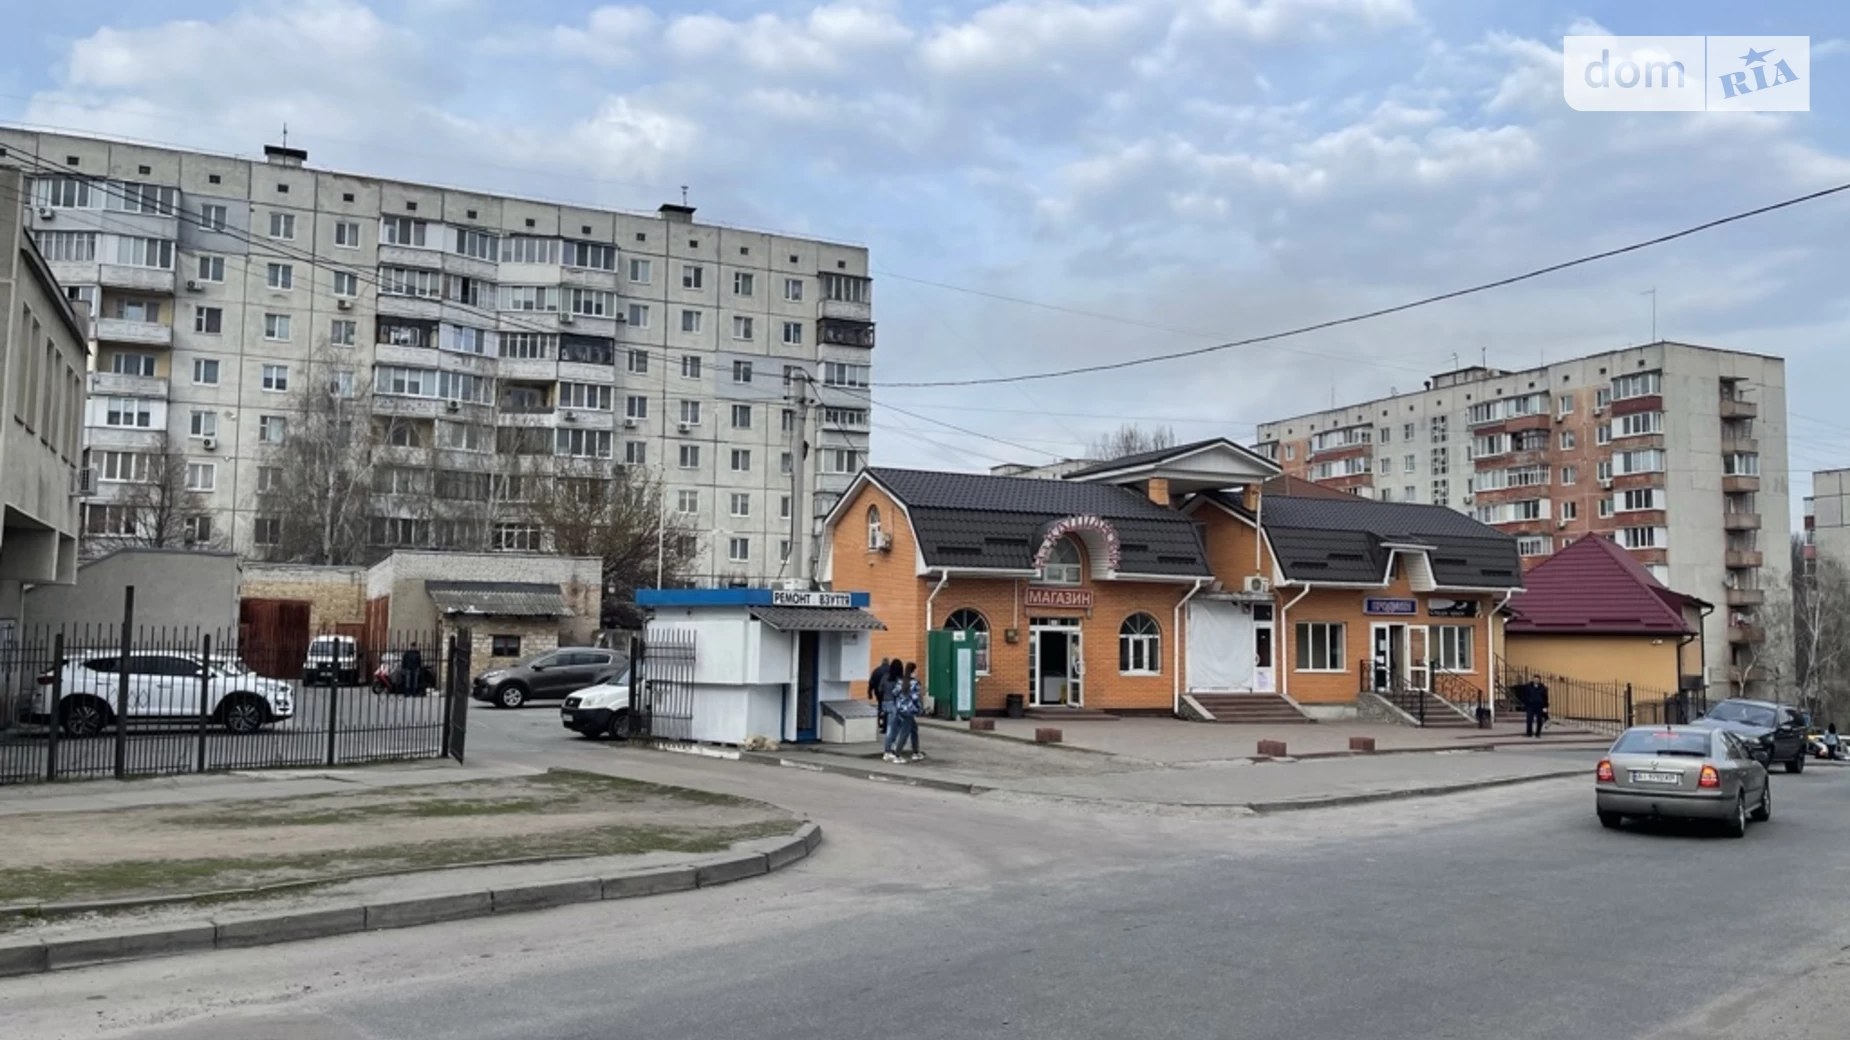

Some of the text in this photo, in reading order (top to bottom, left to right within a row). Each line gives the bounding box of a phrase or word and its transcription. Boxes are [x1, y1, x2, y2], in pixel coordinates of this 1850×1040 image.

[774, 592, 849, 606] РЕМОНТ ВЗУТТЯ
[1029, 590, 1091, 605] МАГАЗИН
